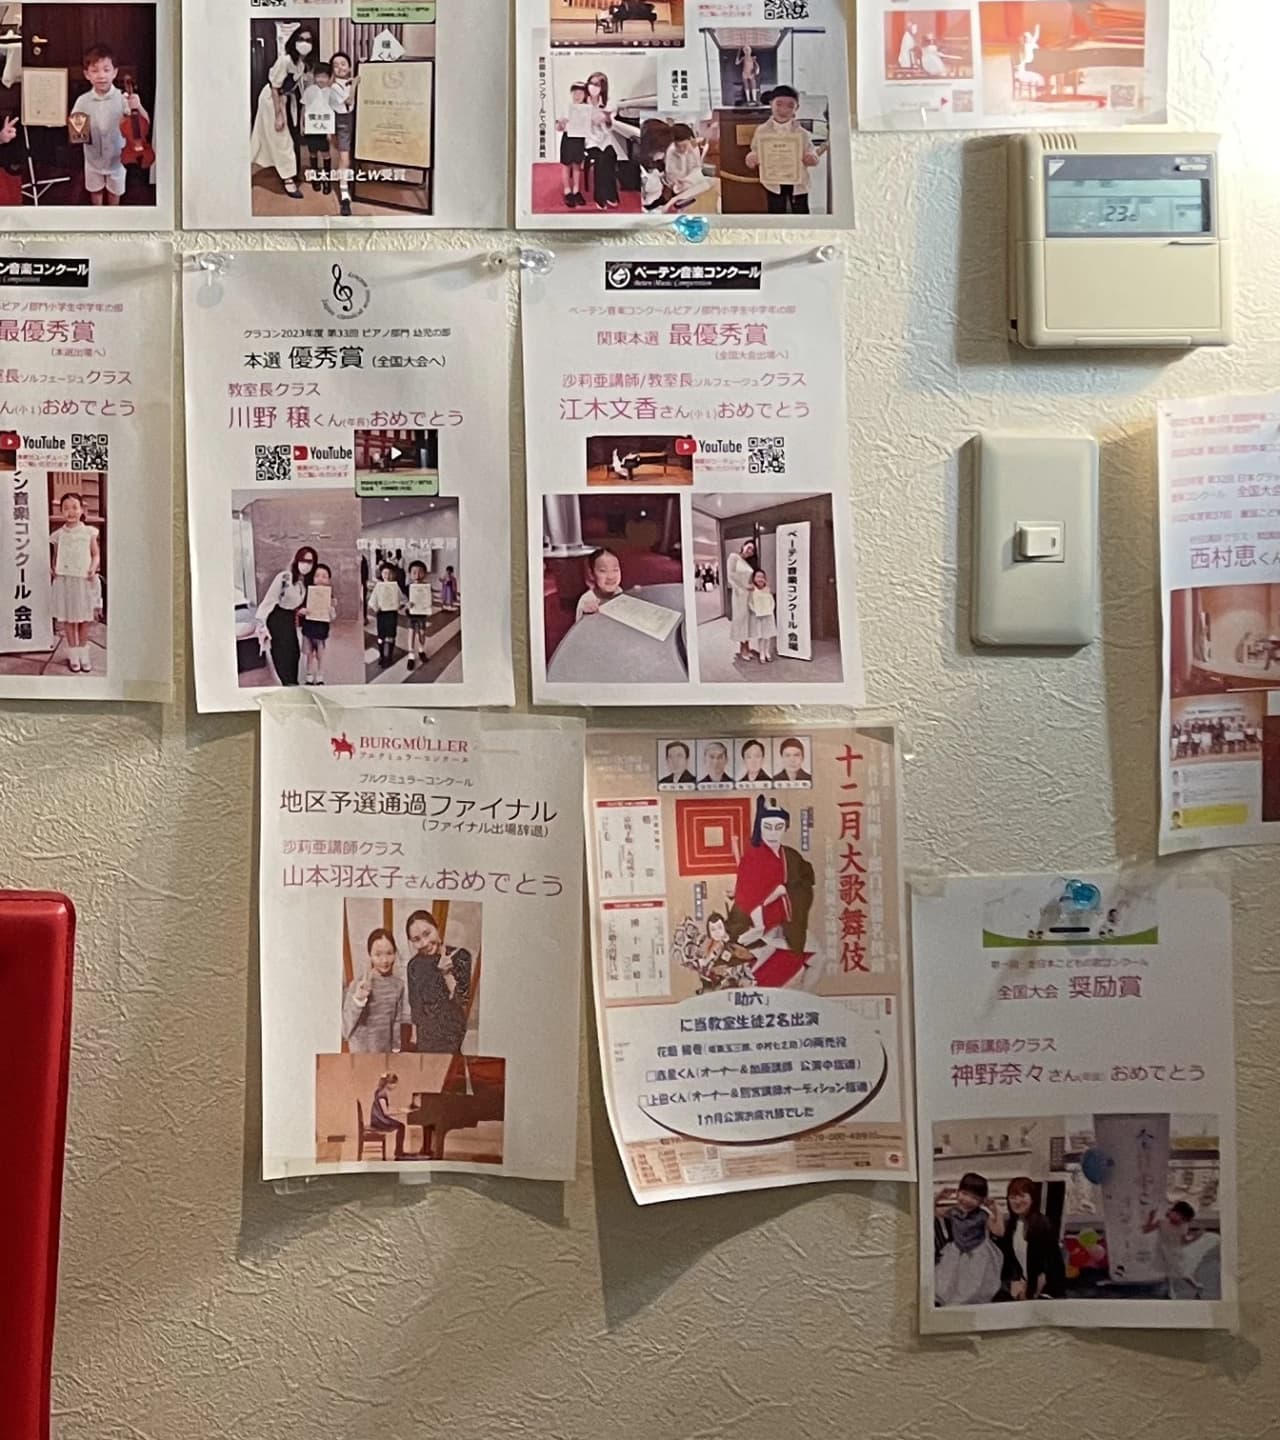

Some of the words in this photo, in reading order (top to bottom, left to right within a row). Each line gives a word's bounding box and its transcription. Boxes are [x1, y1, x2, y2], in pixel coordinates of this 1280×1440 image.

[634, 265, 761, 279] ベーテン音楽コンクール
[362, 328, 410, 339] ピアノ部門
[597, 330, 659, 346] 関東本選
[668, 322, 768, 346] 最優秀賞
[243, 351, 282, 368] 本選
[287, 345, 363, 369] 優秀賞
[227, 382, 321, 397] 教室長クラス
[22, 435, 66, 450] YouTube
[698, 438, 742, 454] YouTube
[310, 445, 352, 460] YouTube
[359, 734, 469, 753] BURGMÜLLER
[280, 789, 558, 823] 地区予選通過ファイナル
[282, 839, 405, 857] 沙莉亜講師クラス
[835, 743, 871, 974] 十二月大歌舞伎
[282, 864, 563, 897] 山本羽衣子さんおめでとう
[998, 984, 1059, 1001] 全国大会
[1069, 974, 1143, 999] 奨励賞
